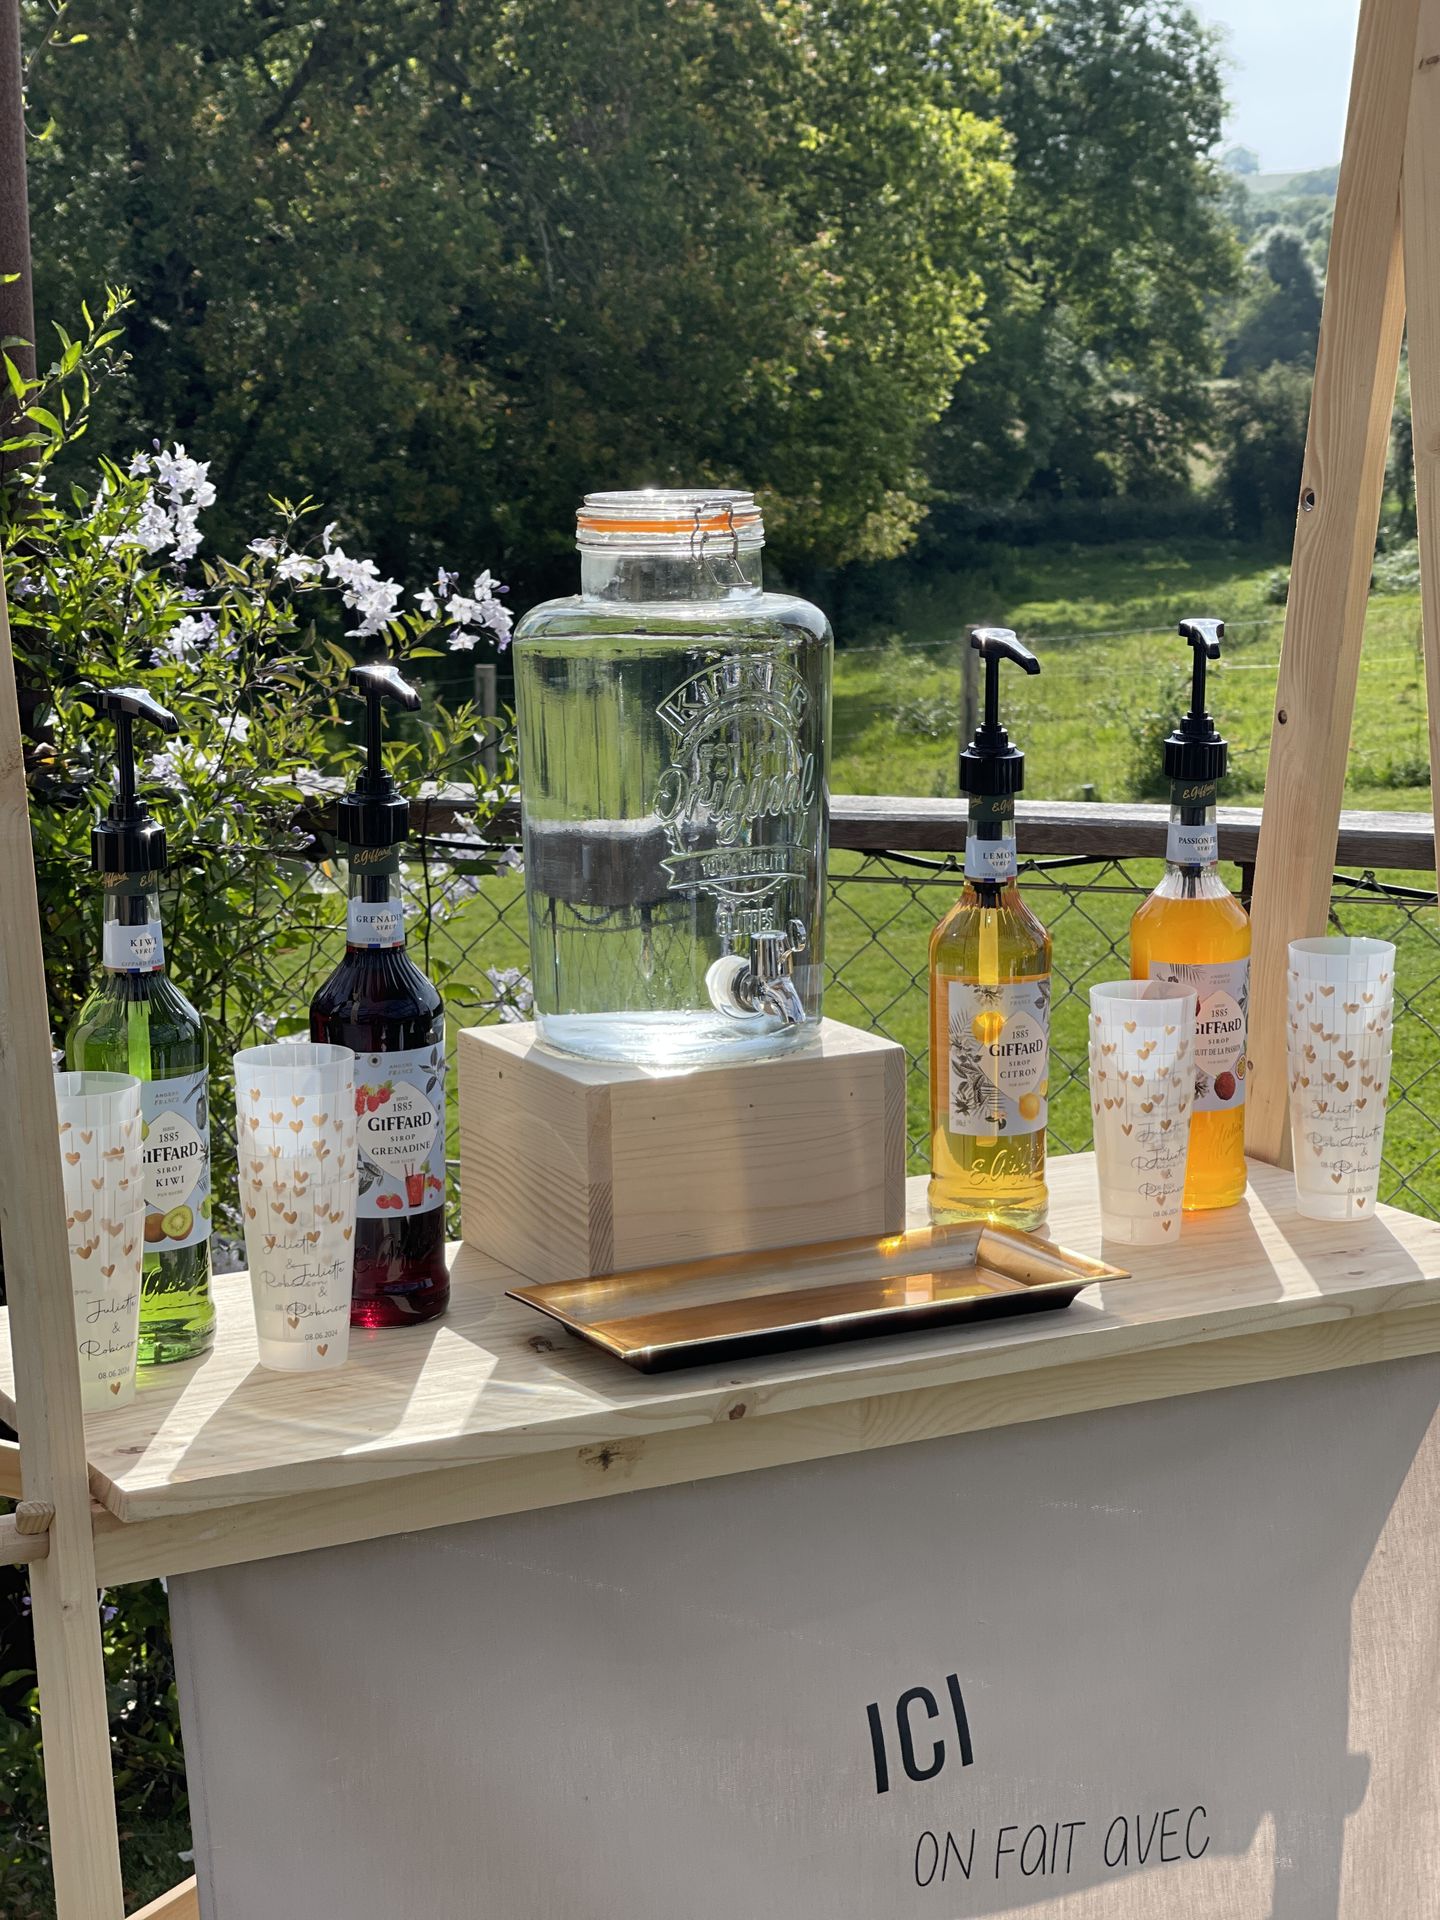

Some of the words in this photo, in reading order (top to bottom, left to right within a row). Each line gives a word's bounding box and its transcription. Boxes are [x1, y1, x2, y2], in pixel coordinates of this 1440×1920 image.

[653, 753, 815, 845] Original
[1178, 836, 1209, 845] PASSION
[738, 853, 787, 873] QUALITY
[130, 937, 157, 947] KIWI
[1012, 1030, 1029, 1040] 1885
[989, 1038, 1043, 1057] GIFFARD
[1209, 1048, 1217, 1056] DE
[999, 1068, 1037, 1079] CITRON
[393, 1101, 413, 1112] 1885
[368, 1111, 432, 1132] GIFFARD
[159, 1131, 179, 1144] 1885
[390, 1134, 416, 1142] SIROP
[371, 1141, 431, 1156] GRENADINE
[157, 1165, 183, 1174] SIROP
[156, 1175, 185, 1187] KIWI
[318, 1286, 328, 1298] &
[111, 1321, 121, 1334] &
[304, 1330, 339, 1341] 08.06.2024
[866, 1673, 974, 1794] ICI
[915, 1828, 975, 1887] ON
